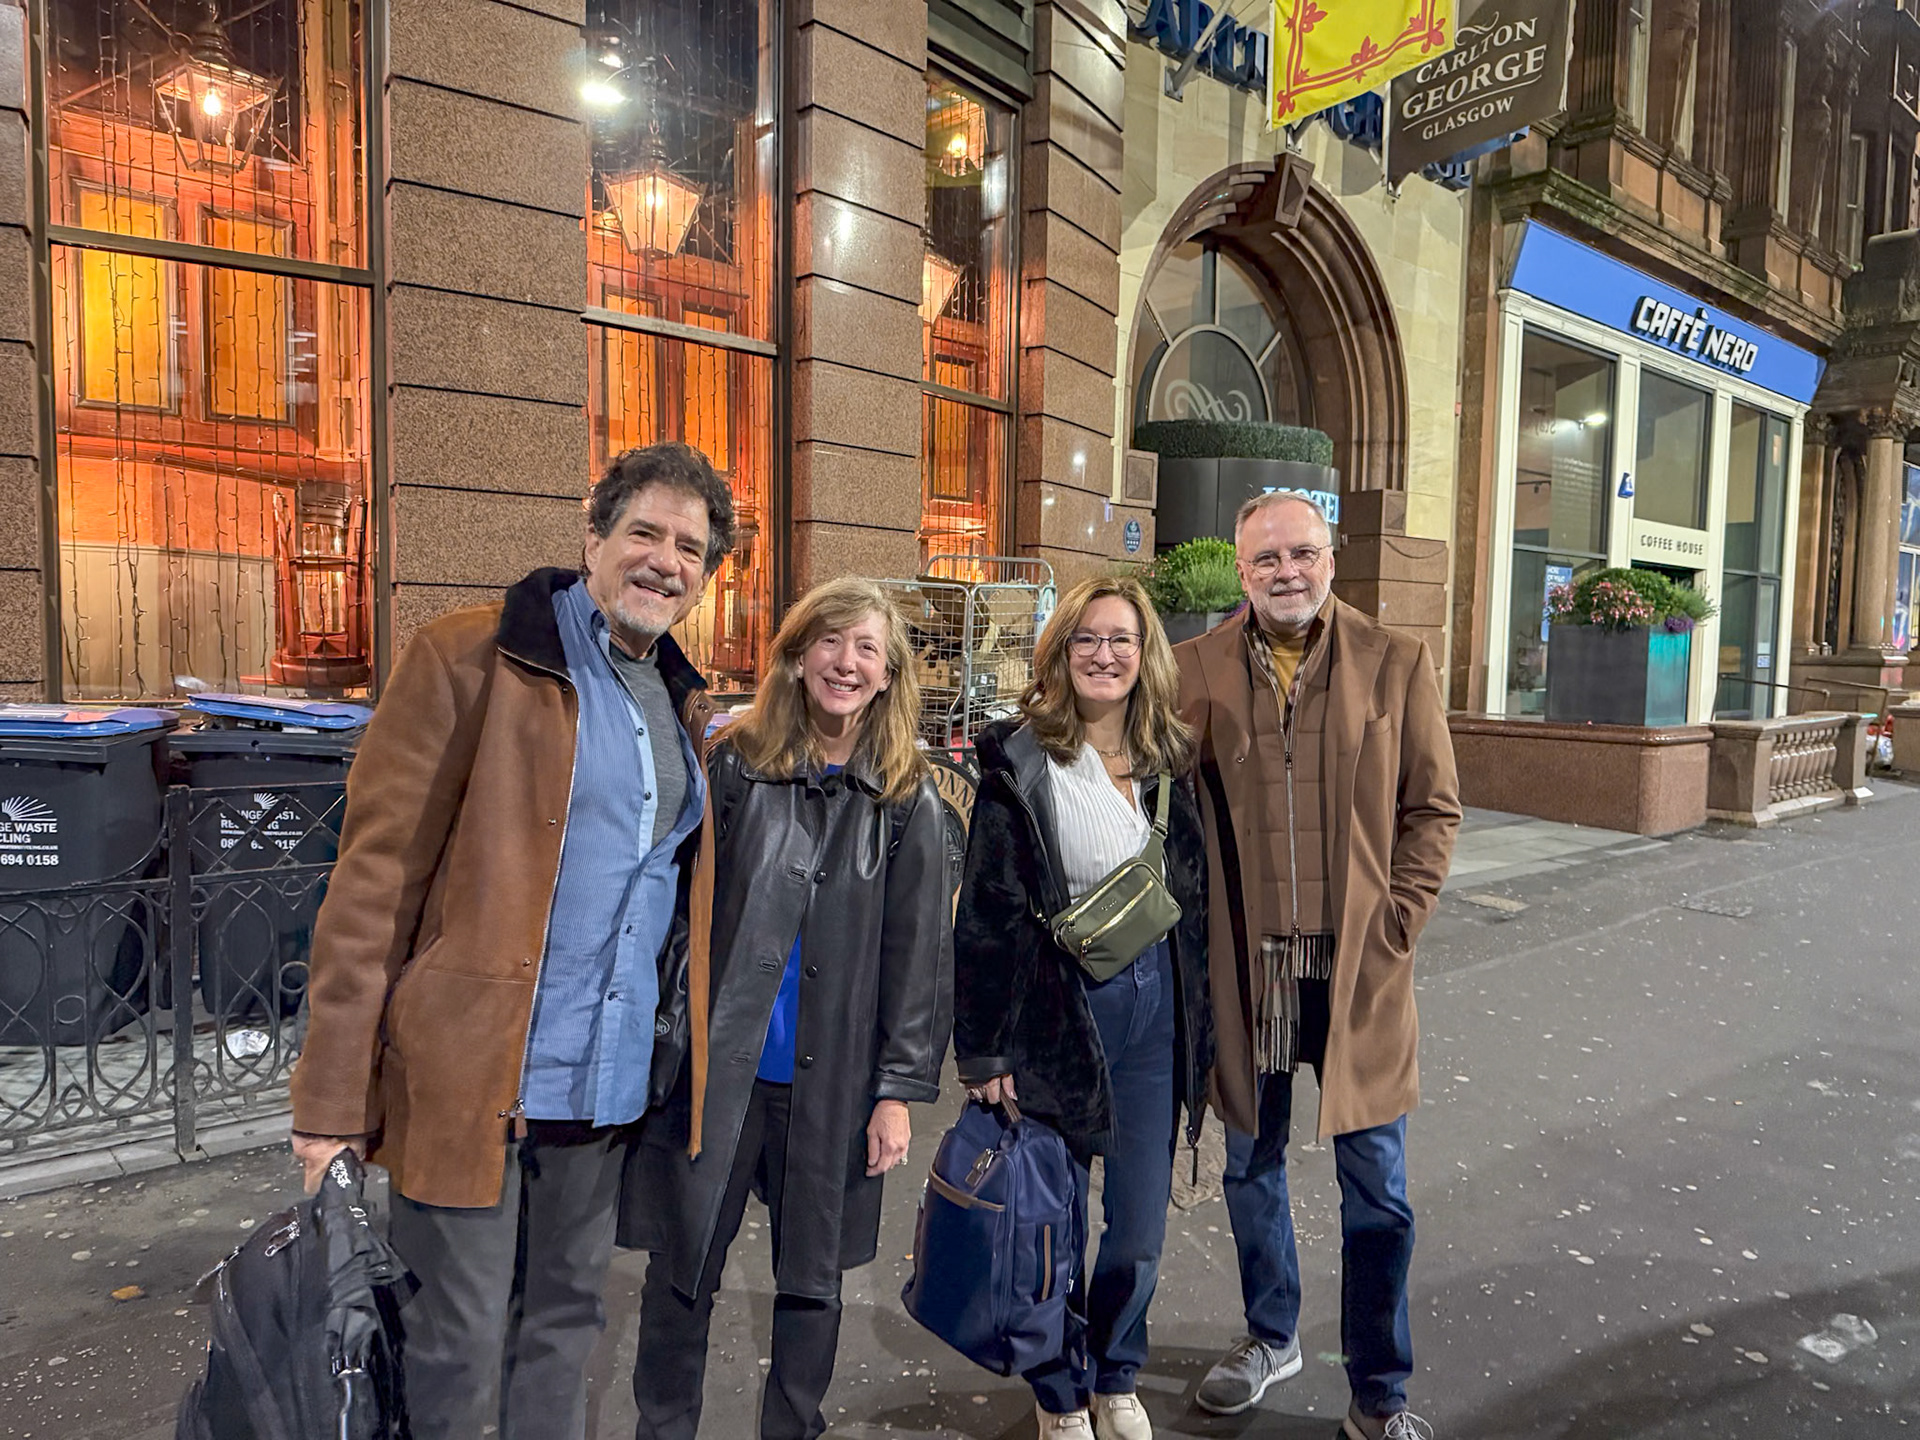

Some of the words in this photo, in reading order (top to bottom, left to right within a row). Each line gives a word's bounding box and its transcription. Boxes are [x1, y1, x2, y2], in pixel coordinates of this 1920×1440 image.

[1416, 17, 1538, 84] CARLTON
[1402, 44, 1547, 119] GEORGE
[1422, 96, 1514, 140] GLASGOW
[1703, 326, 1759, 372] NERO
[1640, 534, 1673, 551] COFFEE
[1676, 540, 1703, 556] HOUSE
[14, 822, 58, 833] WASTE
[0, 854, 24, 866] 694
[26, 854, 60, 866] 0158
